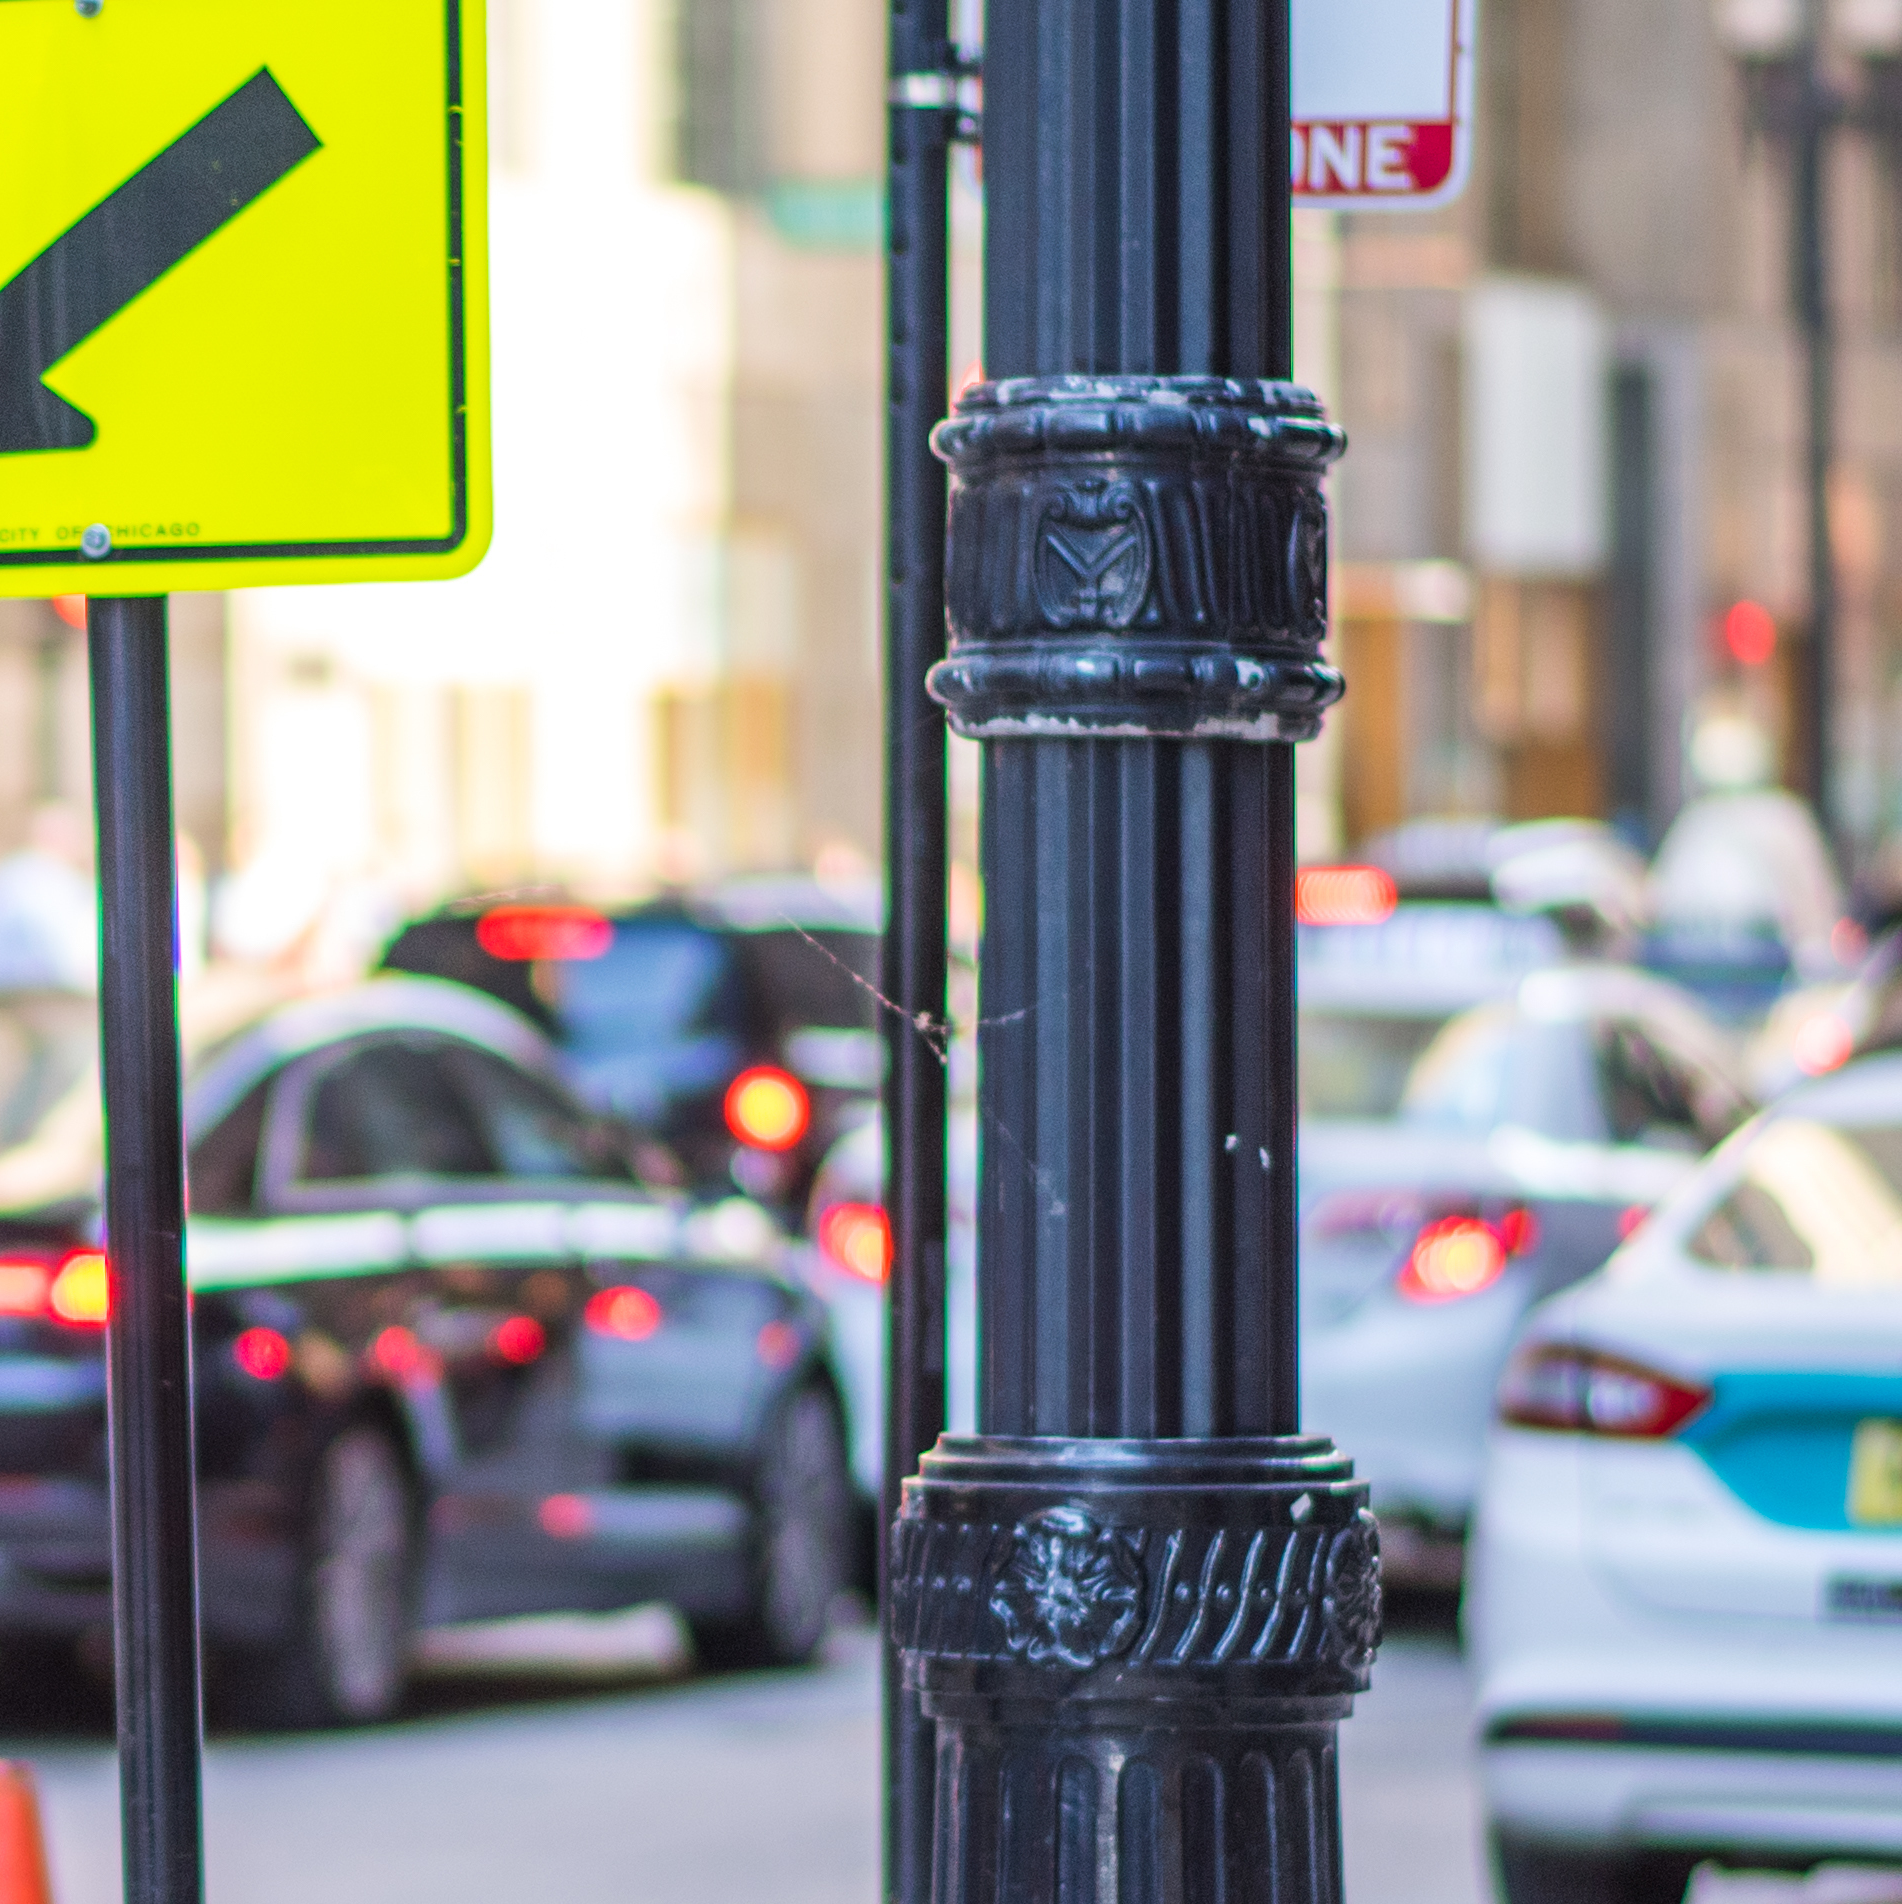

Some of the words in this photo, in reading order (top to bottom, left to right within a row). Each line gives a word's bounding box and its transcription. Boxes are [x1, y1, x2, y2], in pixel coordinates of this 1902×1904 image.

[1292, 125, 1412, 190] NE
[56, 526, 82, 541] OF
[107, 522, 200, 538] HICAGO
